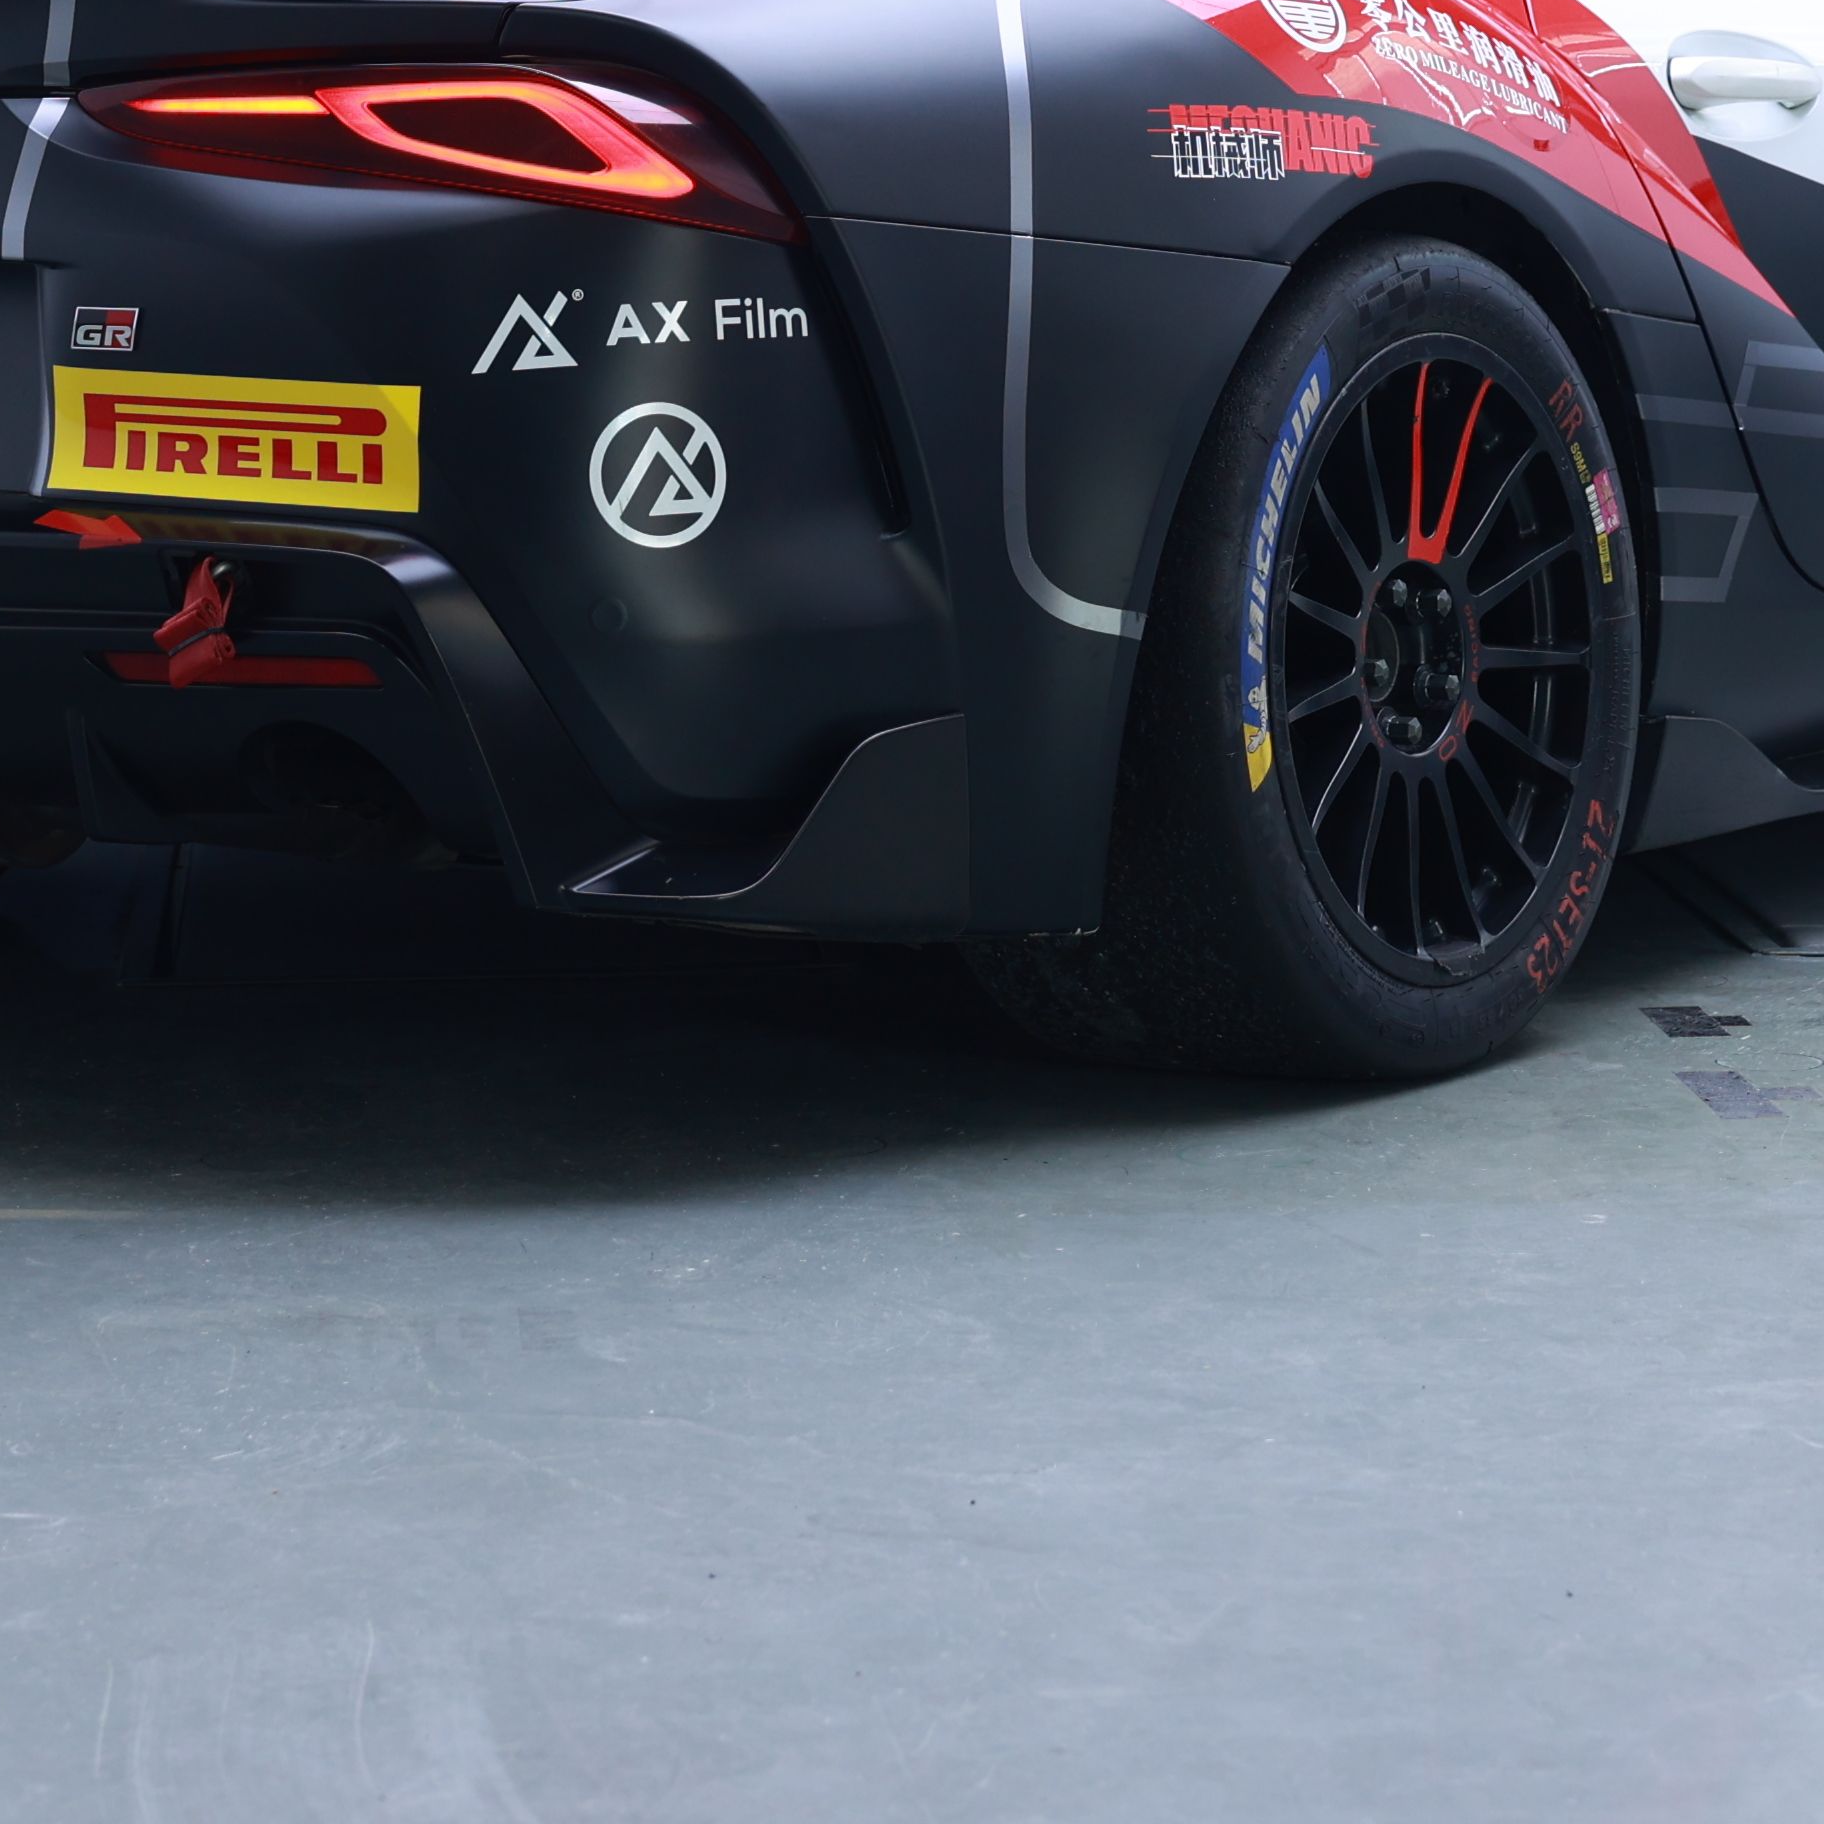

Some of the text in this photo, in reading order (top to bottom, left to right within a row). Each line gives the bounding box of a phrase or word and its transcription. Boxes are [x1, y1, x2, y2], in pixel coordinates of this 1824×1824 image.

[1371, 36, 1569, 135] ZERO MILEAGE LUBRICANT
[76, 323, 132, 347] GR
[606, 298, 809, 347] AX Film
[82, 393, 388, 485] PIRELLI
[1247, 373, 1321, 665] MICHELIN
